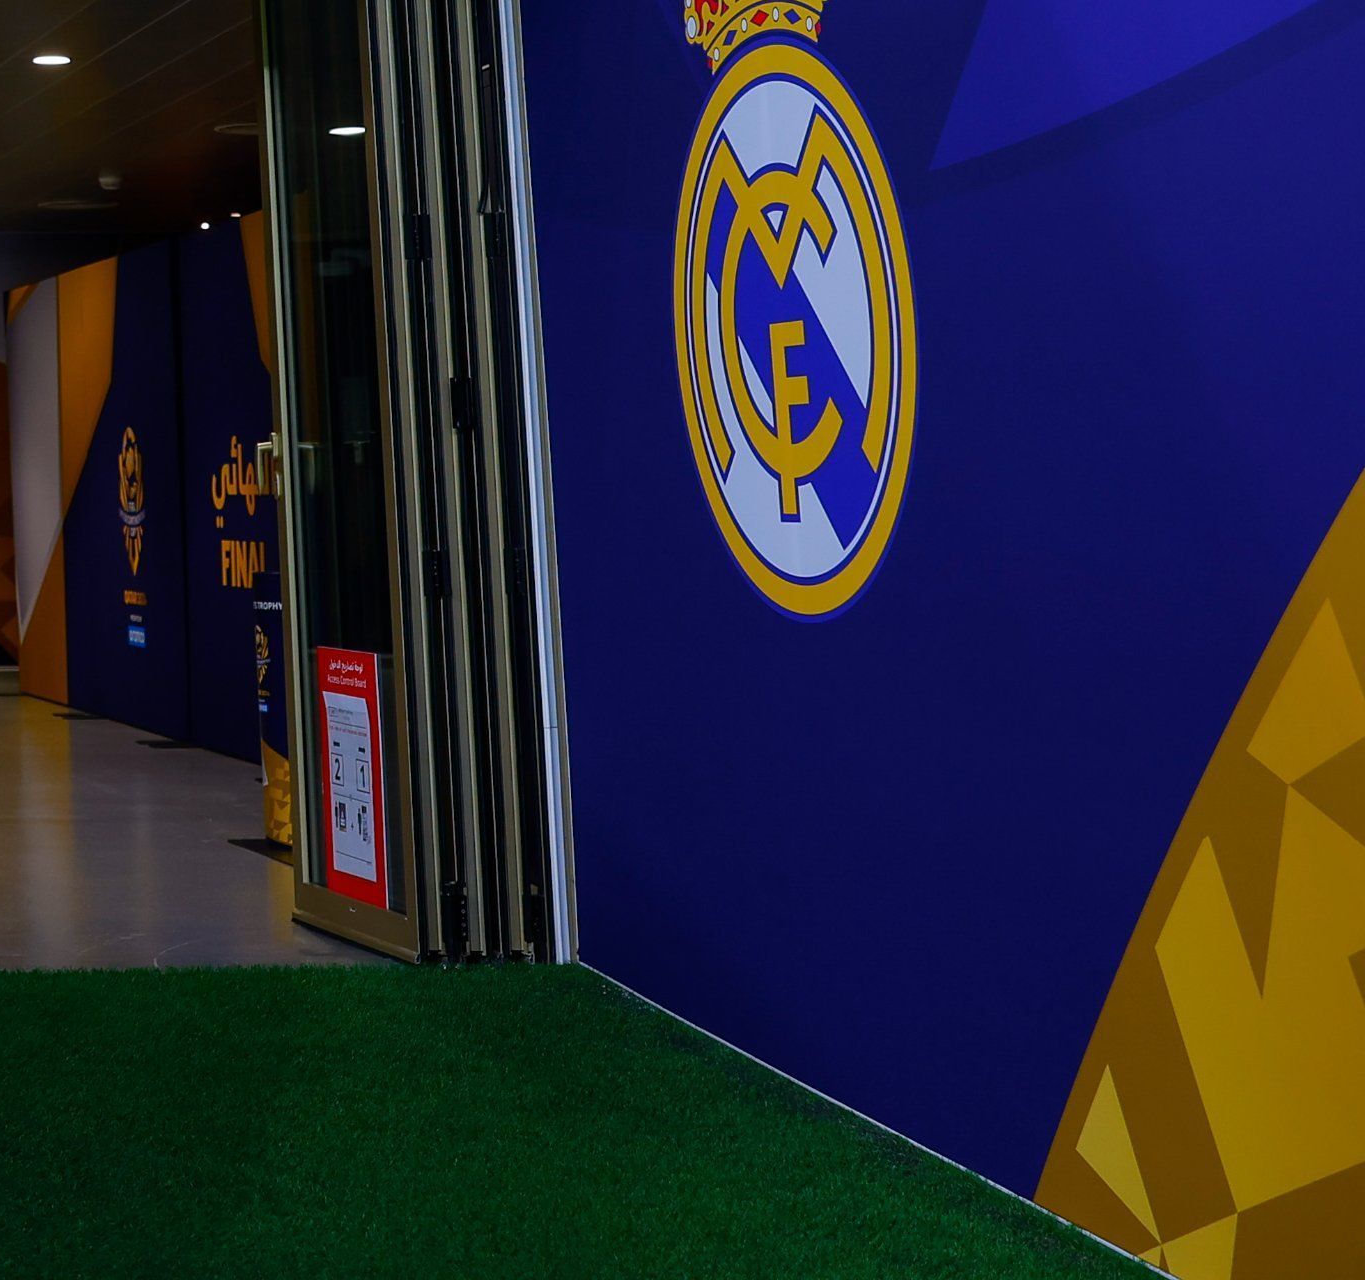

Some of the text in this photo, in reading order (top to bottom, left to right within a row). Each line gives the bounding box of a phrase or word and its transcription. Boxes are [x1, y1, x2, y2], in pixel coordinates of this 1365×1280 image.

[341, 675, 354, 686] Control
[354, 677, 367, 689] Board
[334, 757, 366, 788] 2 1
